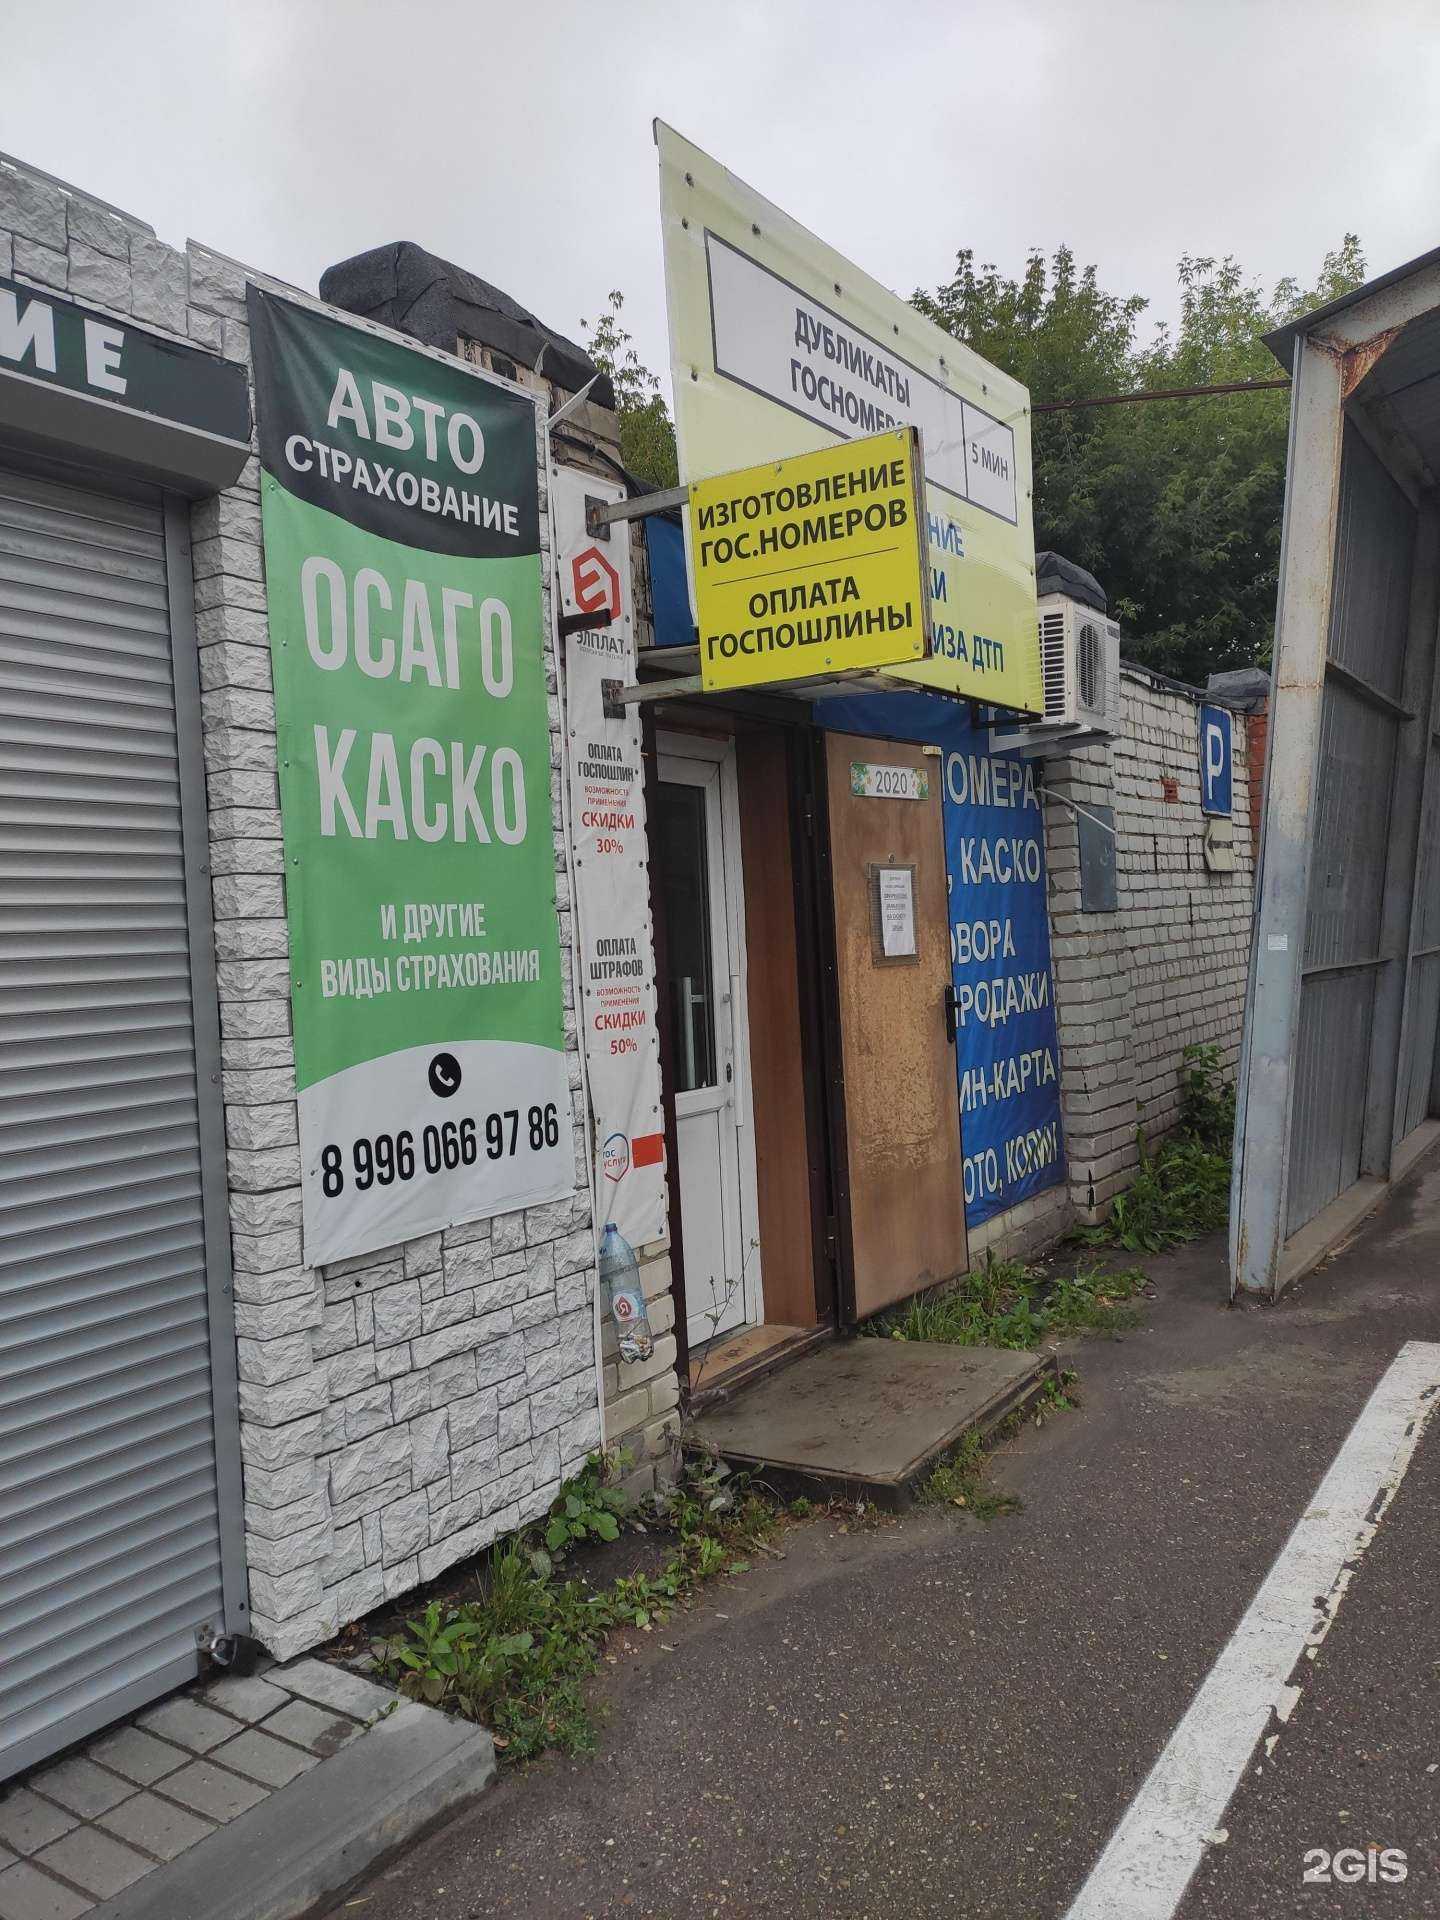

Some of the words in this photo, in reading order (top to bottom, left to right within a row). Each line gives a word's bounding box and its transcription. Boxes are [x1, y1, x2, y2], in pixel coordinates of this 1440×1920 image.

[795, 307, 911, 409] ДУБЛИКАТЫ
[790, 357, 903, 433] ГОСНОМЕР
[326, 367, 485, 475] АВТО
[971, 442, 979, 465] 5
[981, 446, 1009, 481] МИН
[284, 433, 520, 537] СТРАХОВАНИЕ
[698, 459, 906, 531] ИЗГОТОВЛЕНИЕ
[700, 498, 908, 567] ГОС.НОМЕРОВ
[749, 575, 861, 619] ОПЛАТА
[301, 556, 514, 698] ОСАГО
[707, 602, 913, 661] ГОСПОШЛИНЫ
[972, 634, 1004, 674] ДТП
[577, 761, 635, 782] ГОСПОШЛИН
[587, 743, 623, 762] ОПЛАТА
[1206, 723, 1224, 801] P
[313, 723, 528, 846] КАСКО
[584, 785, 630, 797] ВОЗМОЖНОСТЬ
[875, 771, 908, 795] 2020
[940, 750, 1040, 811] ОМЕРА
[581, 811, 635, 832] СКИДКИ
[596, 838, 624, 854] 30%
[960, 837, 1041, 885] КАСКО
[380, 904, 398, 940] И
[403, 903, 487, 943] ДРУГИЕ
[589, 959, 644, 980] ШТРАФОВ
[596, 938, 637, 957] ОПЛАТА
[320, 958, 393, 999] ВИДЫ
[396, 949, 541, 992] СТРАХОВАНИЯ
[596, 985, 642, 997] ВОЗМОЖНОСТЬ
[594, 1010, 646, 1031] СКИДКИ
[953, 971, 1049, 1028] РОДАЖИ
[610, 1038, 638, 1055] 50%
[321, 1144, 344, 1198] 8
[352, 1130, 415, 1191] 996
[422, 1117, 477, 1174] 066
[485, 1109, 519, 1160] 97
[528, 1102, 559, 1151] 86
